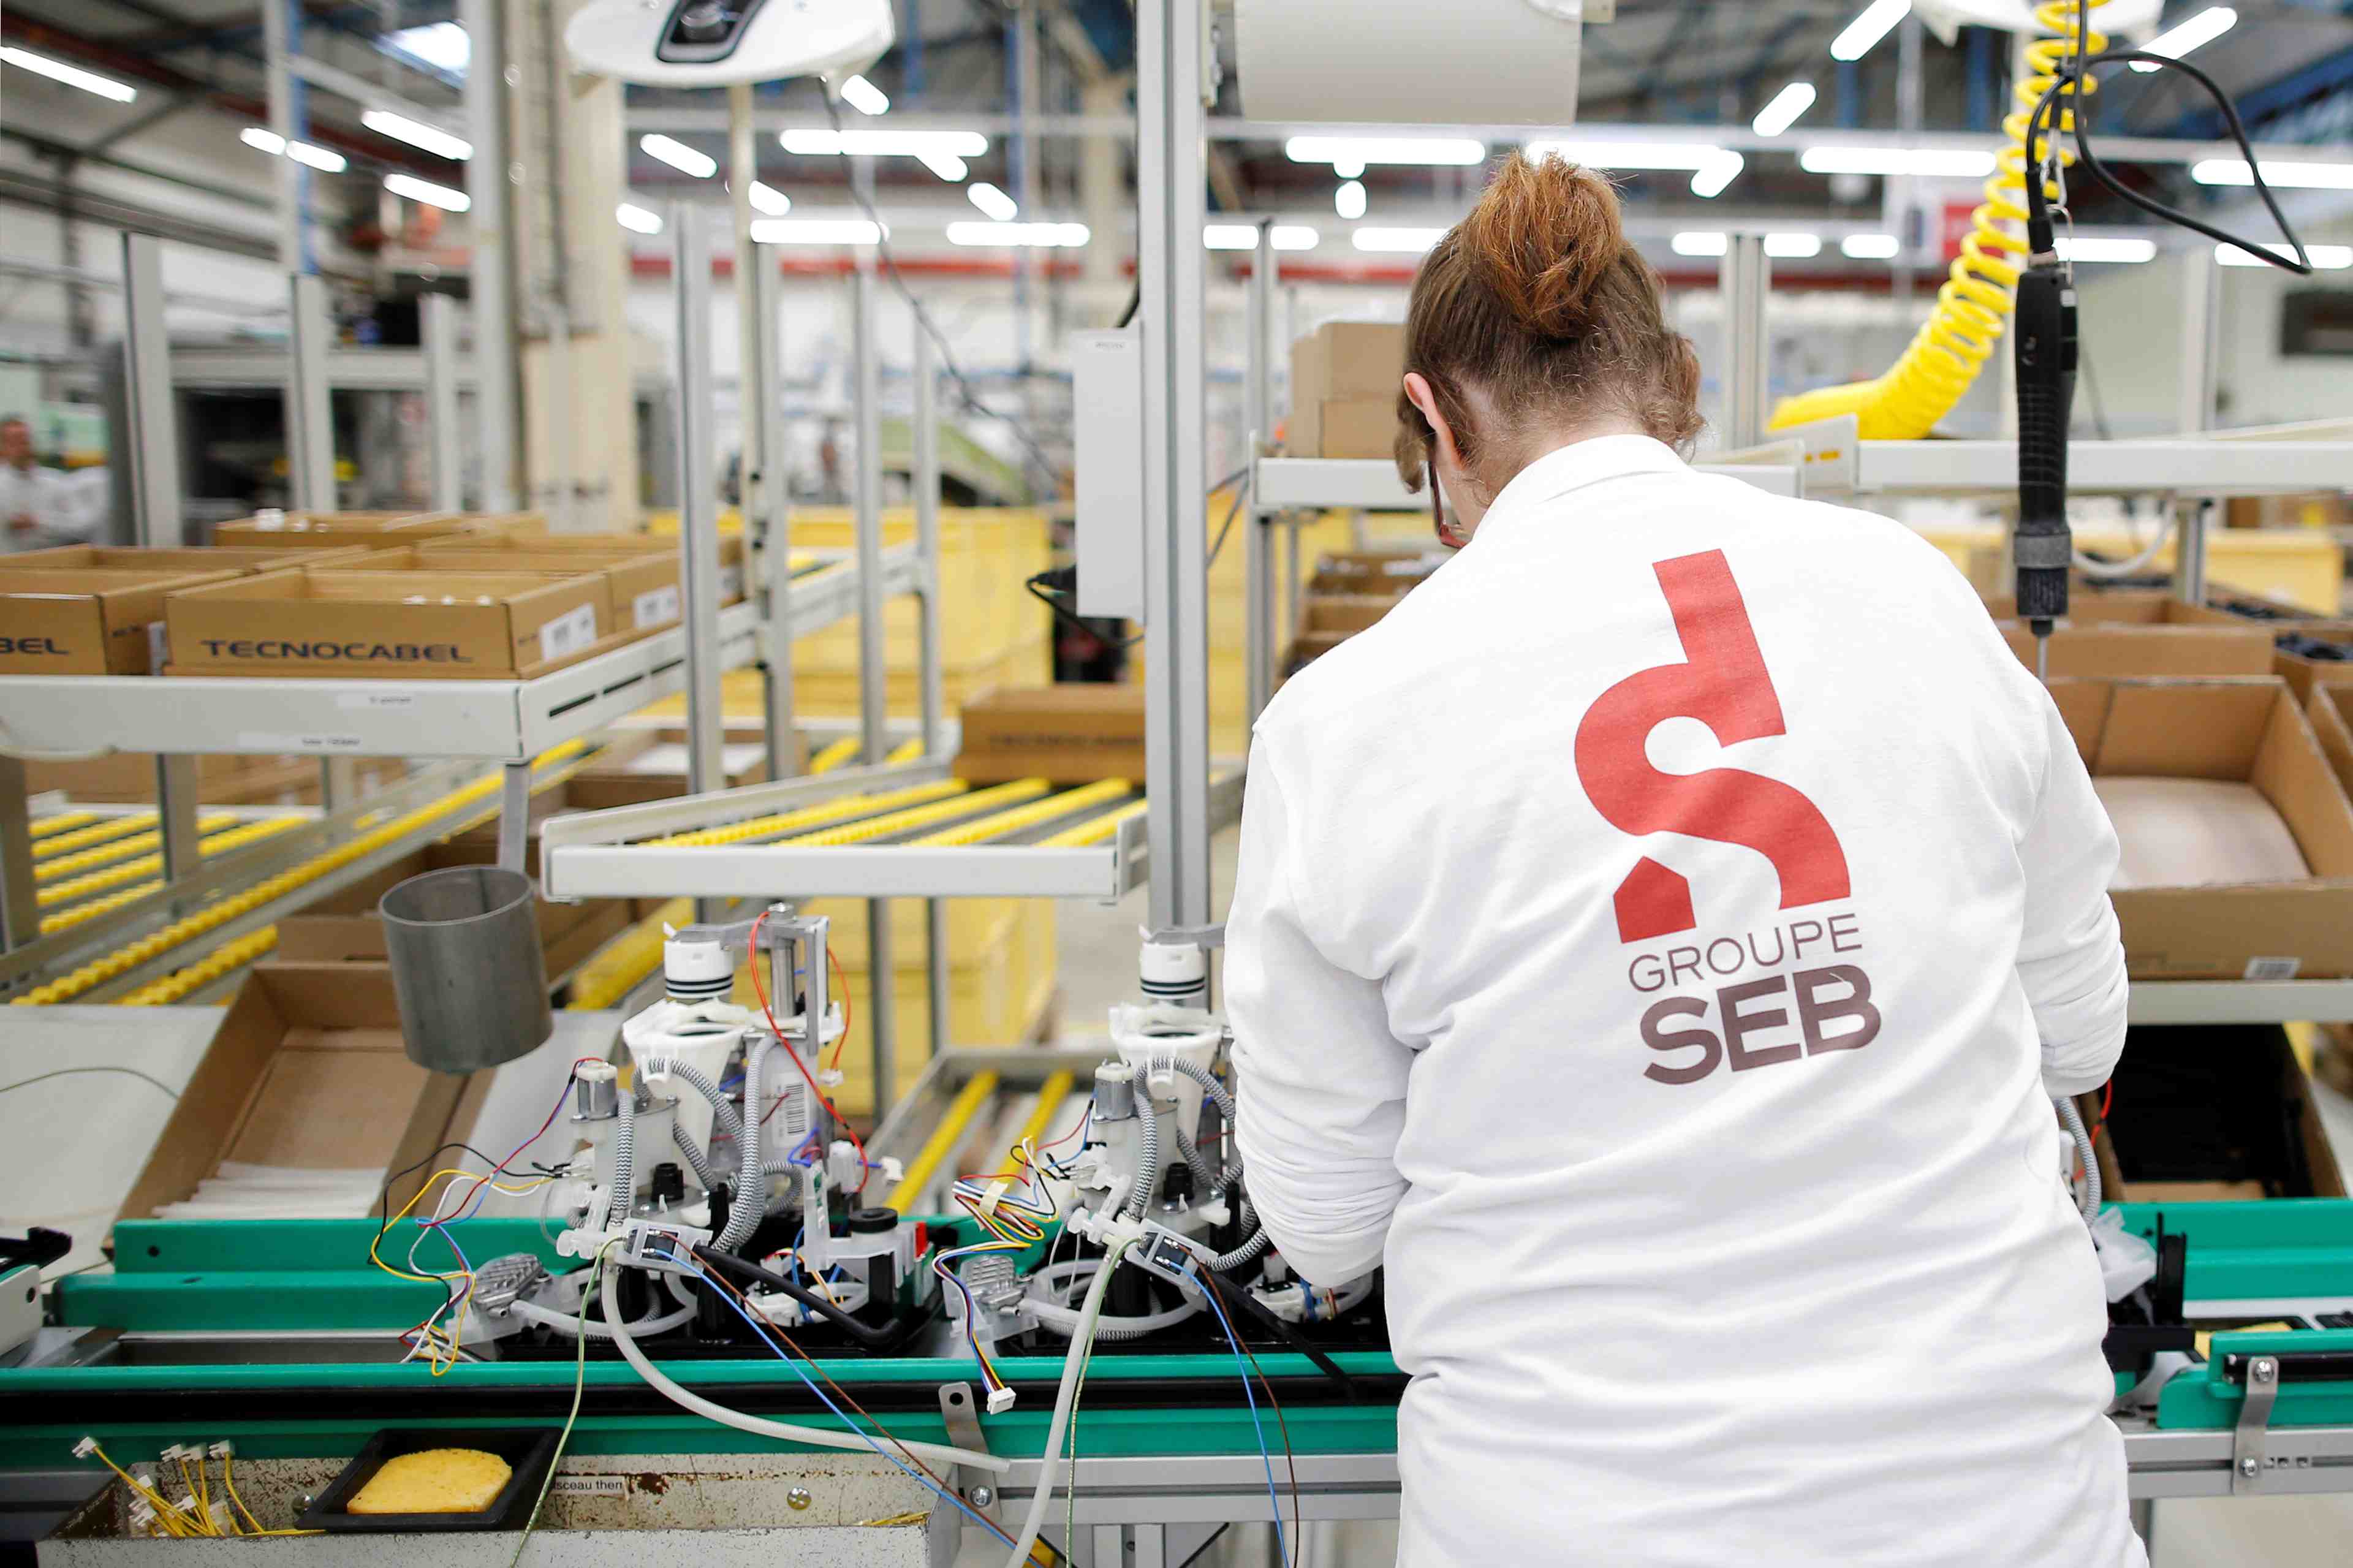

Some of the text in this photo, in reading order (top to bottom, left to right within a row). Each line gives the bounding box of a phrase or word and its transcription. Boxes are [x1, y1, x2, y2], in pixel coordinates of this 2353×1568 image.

[200, 640, 473, 662] TECNOCABEL
[1629, 913, 1862, 992] GROUPE
[1640, 964, 1881, 1085] SEB
